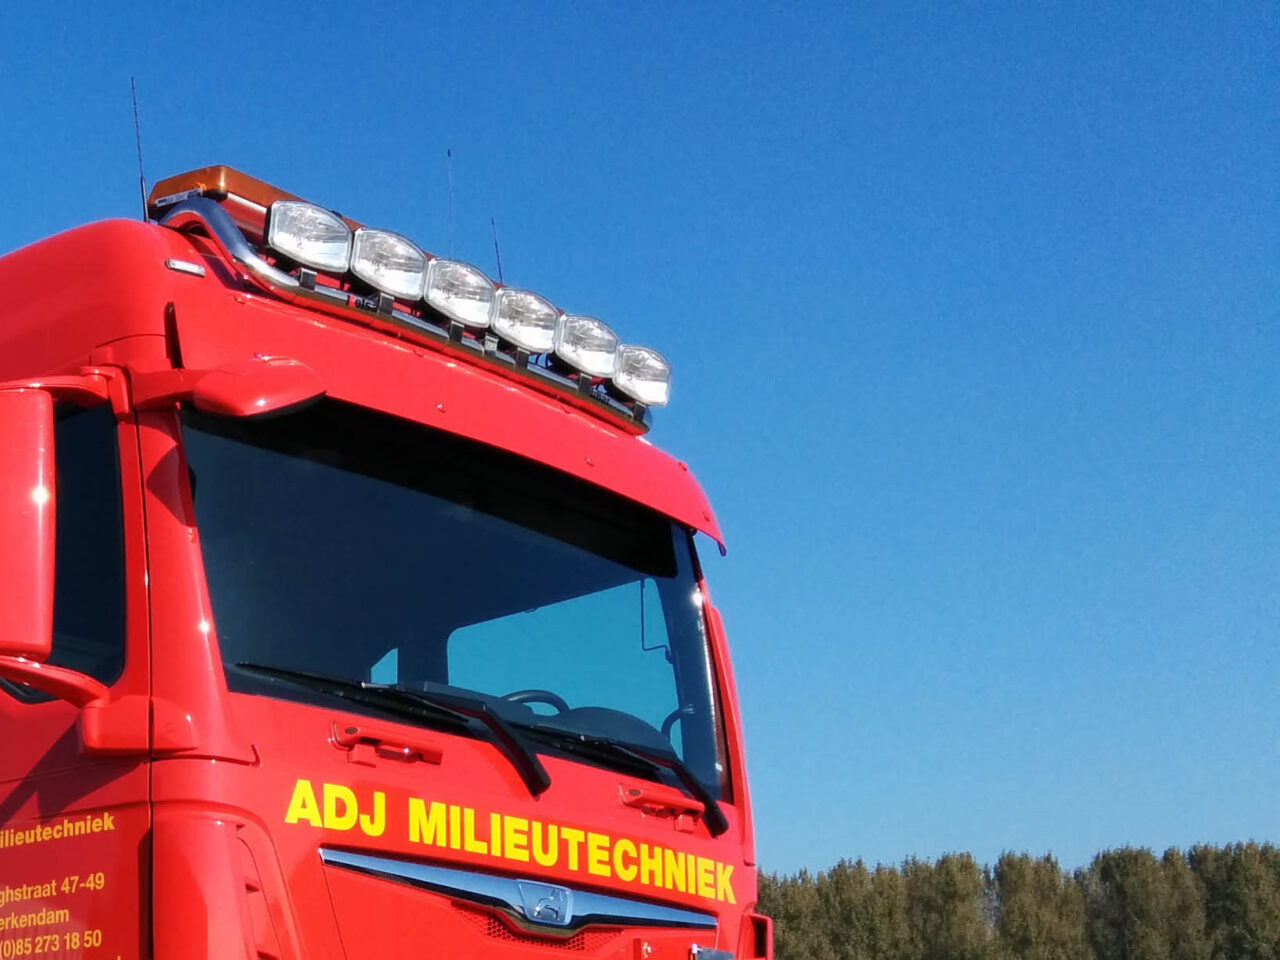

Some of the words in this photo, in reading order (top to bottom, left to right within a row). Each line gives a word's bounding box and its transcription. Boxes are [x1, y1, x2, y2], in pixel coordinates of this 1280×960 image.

[285, 779, 386, 837] ADJ
[409, 798, 736, 904] MILIEUTECHNIEK
[60, 872, 105, 894] 47-49
[34, 934, 60, 953] 273
[64, 931, 80, 950] 18
[84, 929, 102, 948] 50
